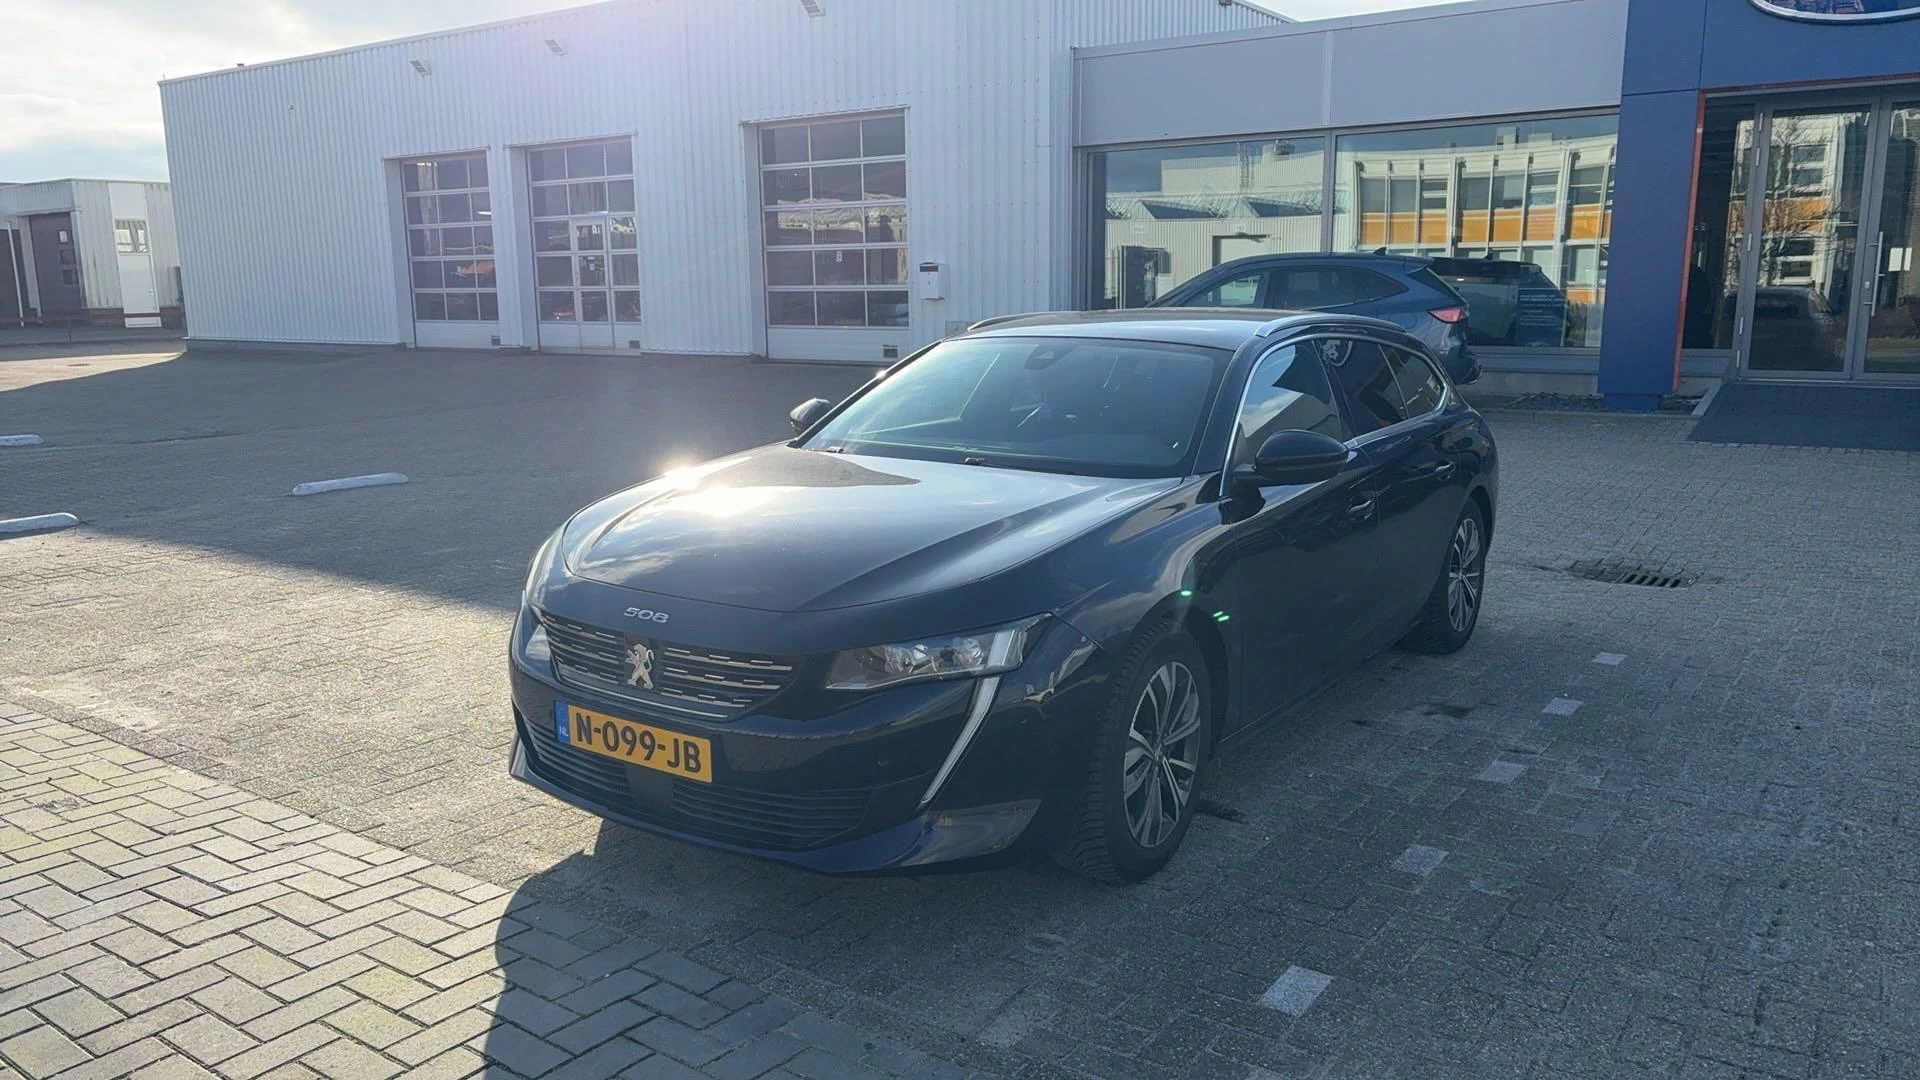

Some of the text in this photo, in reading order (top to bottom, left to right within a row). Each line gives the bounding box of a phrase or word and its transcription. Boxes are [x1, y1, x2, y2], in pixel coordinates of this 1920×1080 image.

[624, 607, 669, 623] 508
[559, 725, 568, 737] NL
[575, 712, 702, 773] N-099-JB
